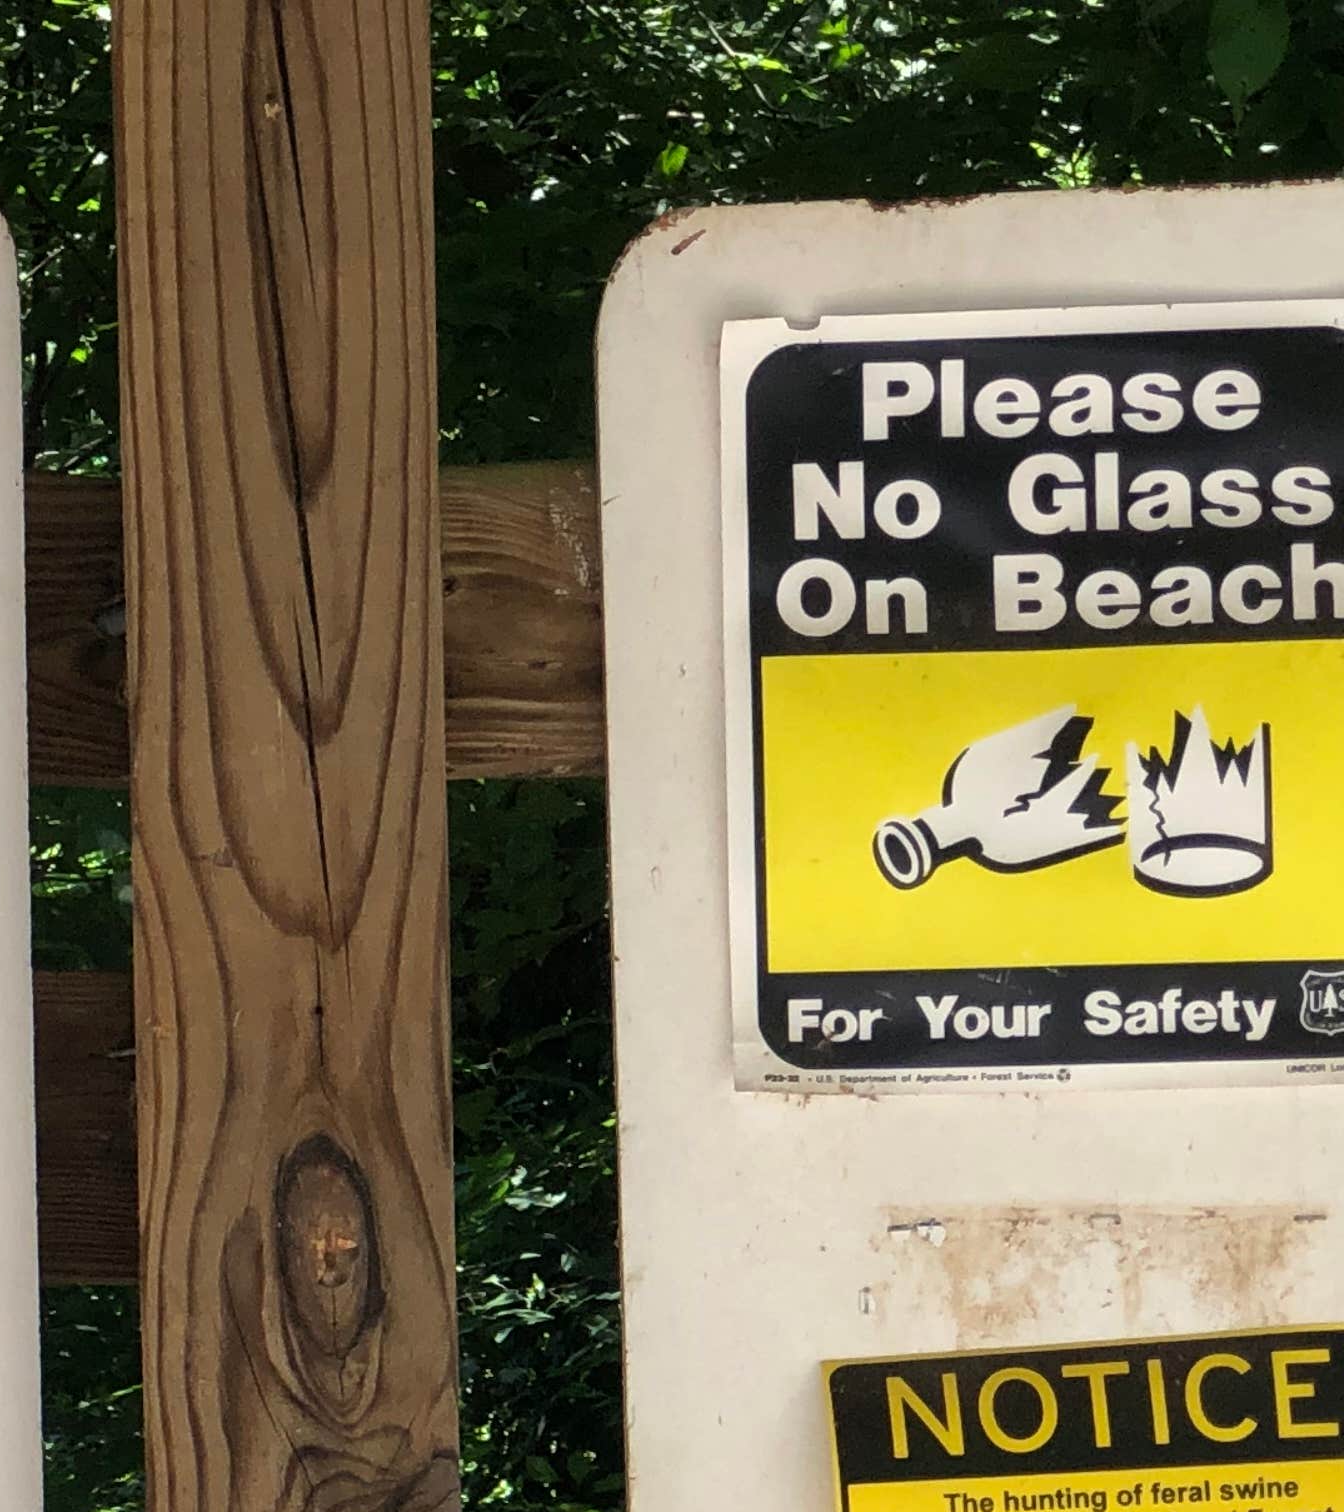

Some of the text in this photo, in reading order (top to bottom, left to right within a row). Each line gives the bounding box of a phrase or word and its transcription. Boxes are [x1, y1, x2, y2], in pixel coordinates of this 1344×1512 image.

[861, 358, 1263, 443] Please
[791, 452, 1337, 543] No Glass
[775, 543, 1344, 638] On Beach
[787, 988, 1278, 1043] For Your Safety
[884, 1347, 1342, 1460] NOTICE
[1116, 1482, 1145, 1507] of
[1150, 1480, 1212, 1505] feral
[1219, 1477, 1300, 1502] swine
